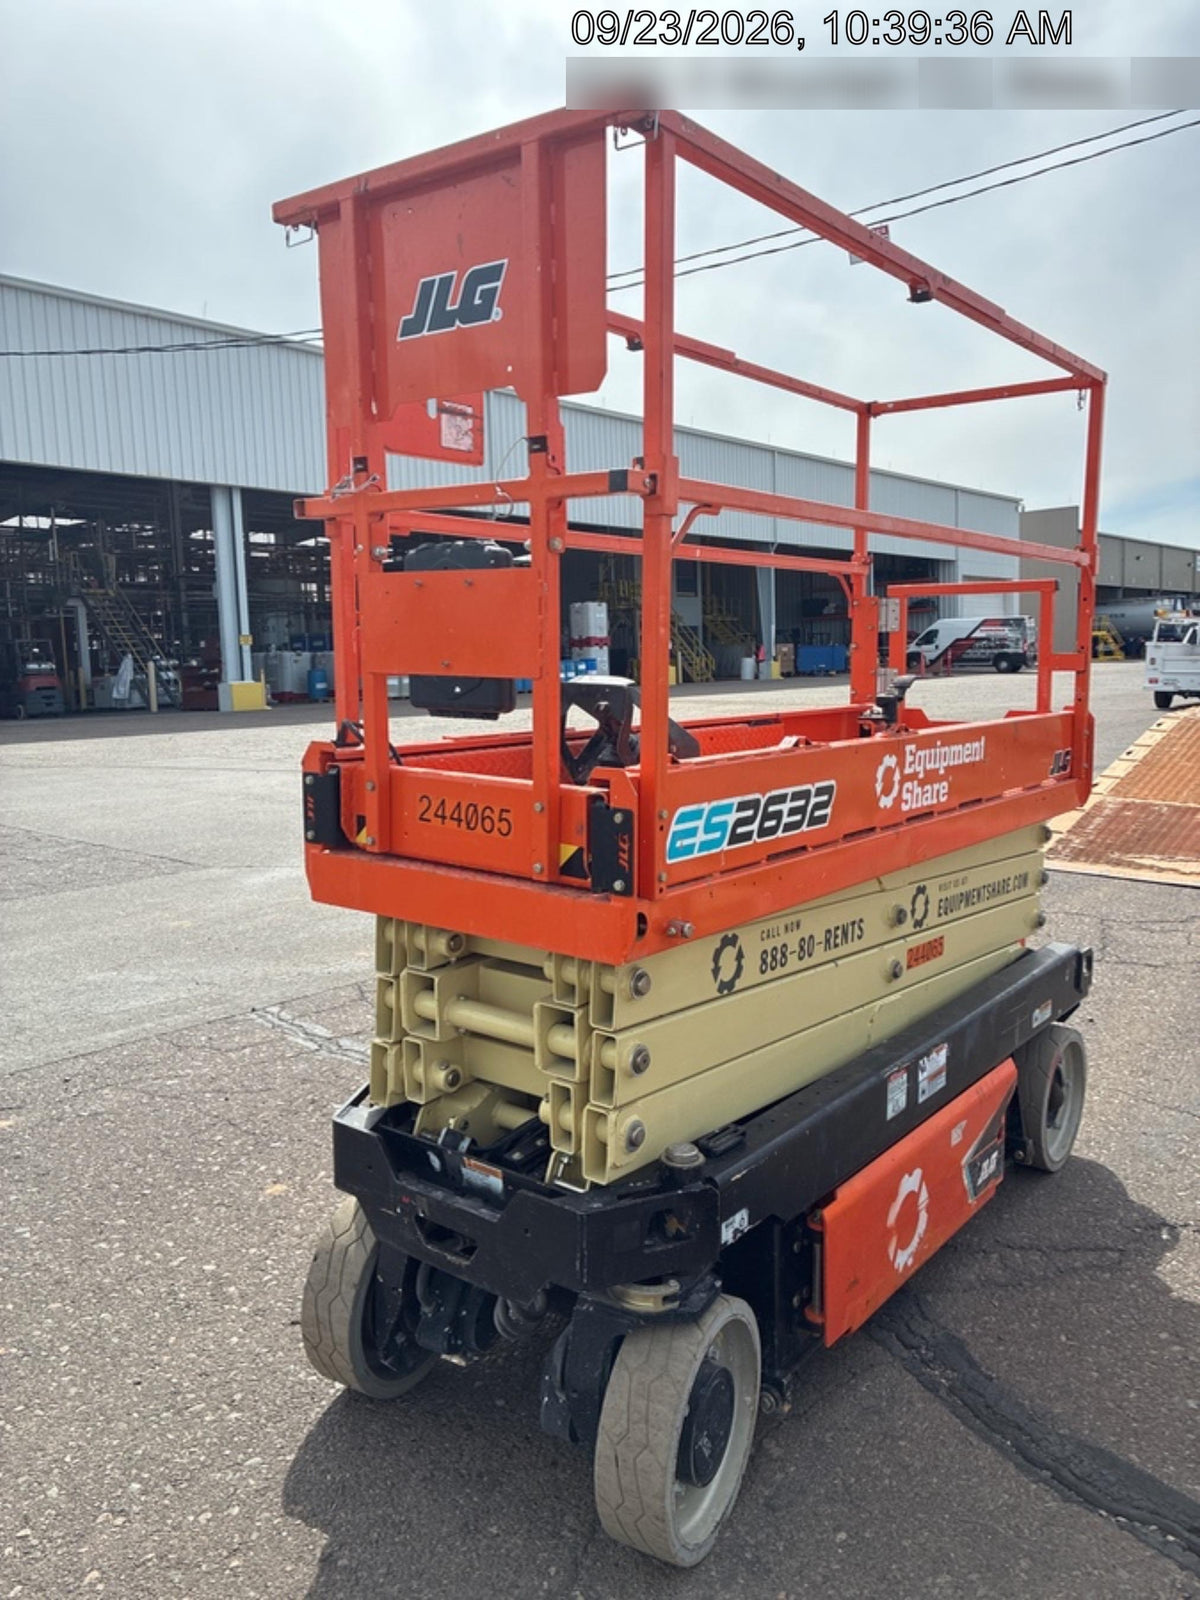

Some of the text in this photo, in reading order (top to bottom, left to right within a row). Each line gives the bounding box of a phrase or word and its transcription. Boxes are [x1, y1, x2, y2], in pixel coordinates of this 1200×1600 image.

[396, 258, 508, 342] JLG
[903, 735, 985, 779] Equipment
[418, 794, 513, 837] 244065
[901, 780, 949, 812] Share
[666, 780, 837, 864] ES2632
[759, 917, 865, 975] 888-80-RENTS
[760, 925, 781, 942] CALL
